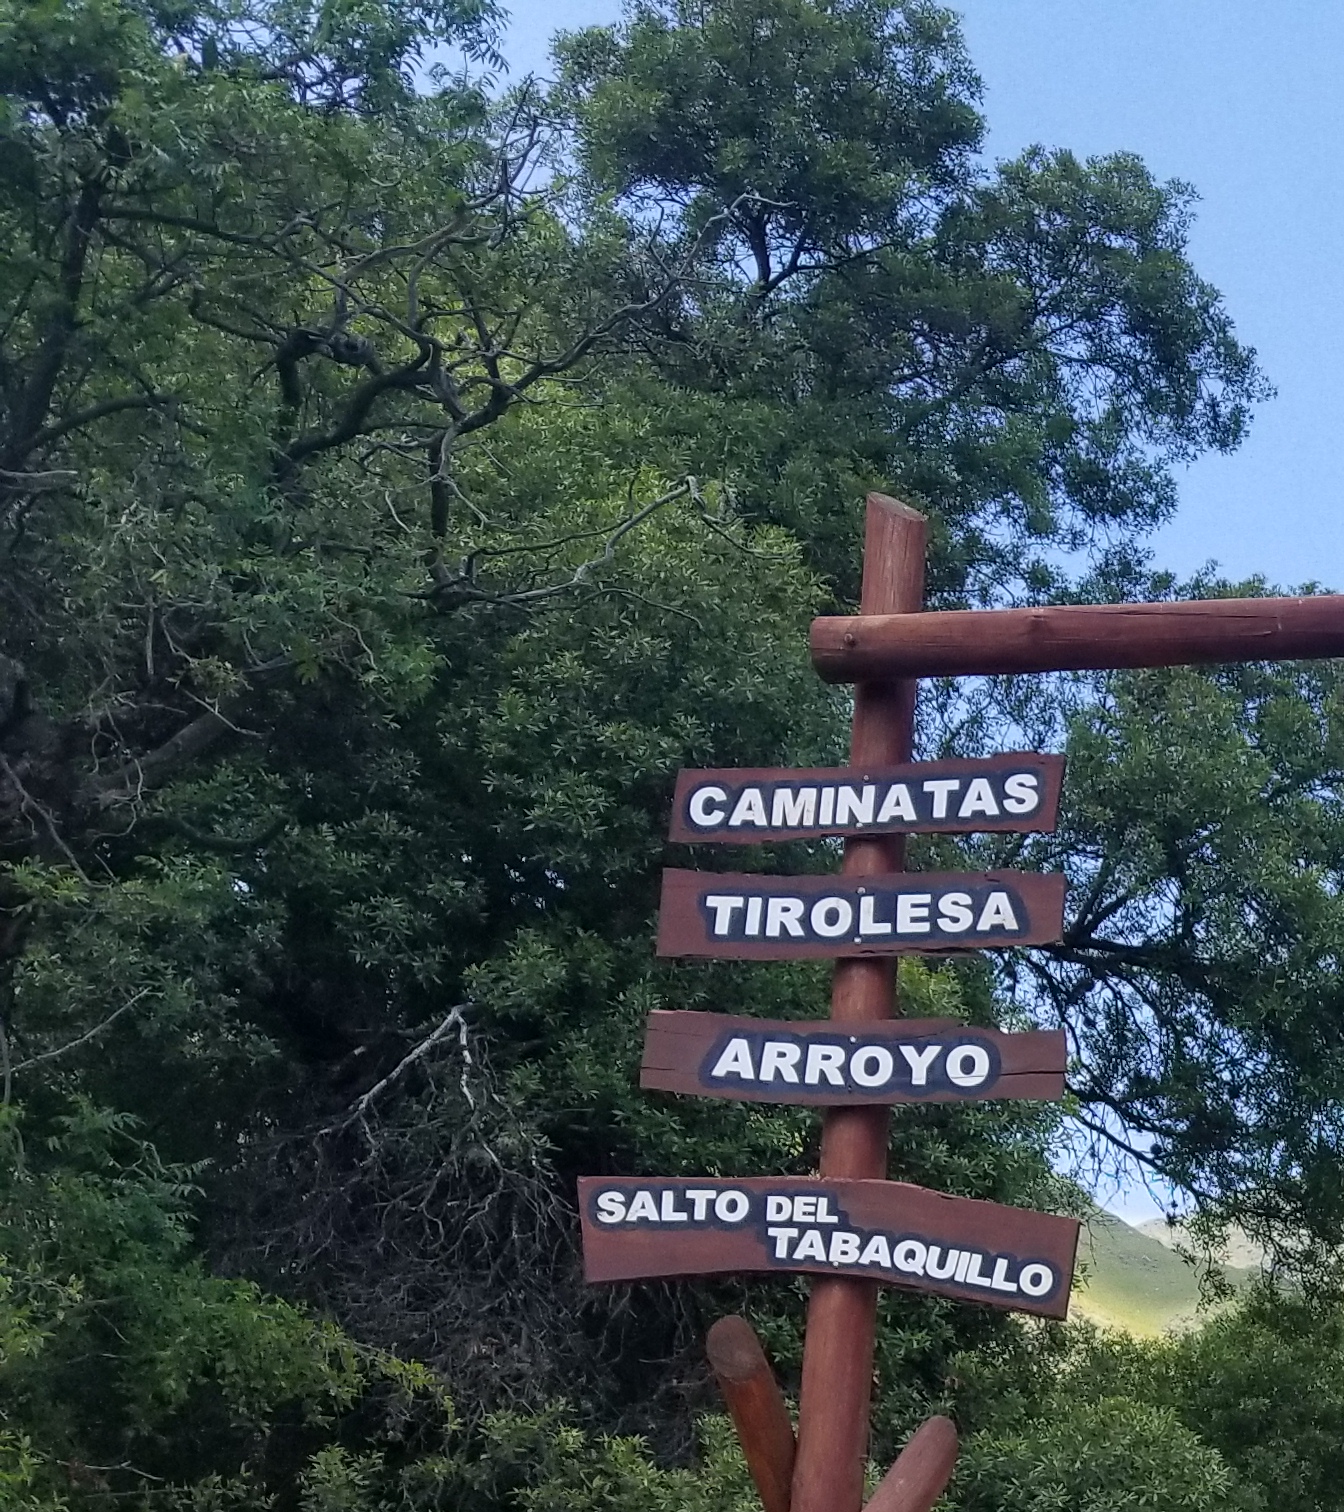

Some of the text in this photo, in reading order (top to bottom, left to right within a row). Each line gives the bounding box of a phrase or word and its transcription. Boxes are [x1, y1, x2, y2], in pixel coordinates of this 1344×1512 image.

[689, 773, 1040, 828] CAMINATAS
[705, 891, 1019, 937] TIROLESA
[711, 1038, 990, 1087] ARROYO
[596, 1189, 839, 1224] SALTO DEL
[767, 1227, 1054, 1297] TABAQUILLO
